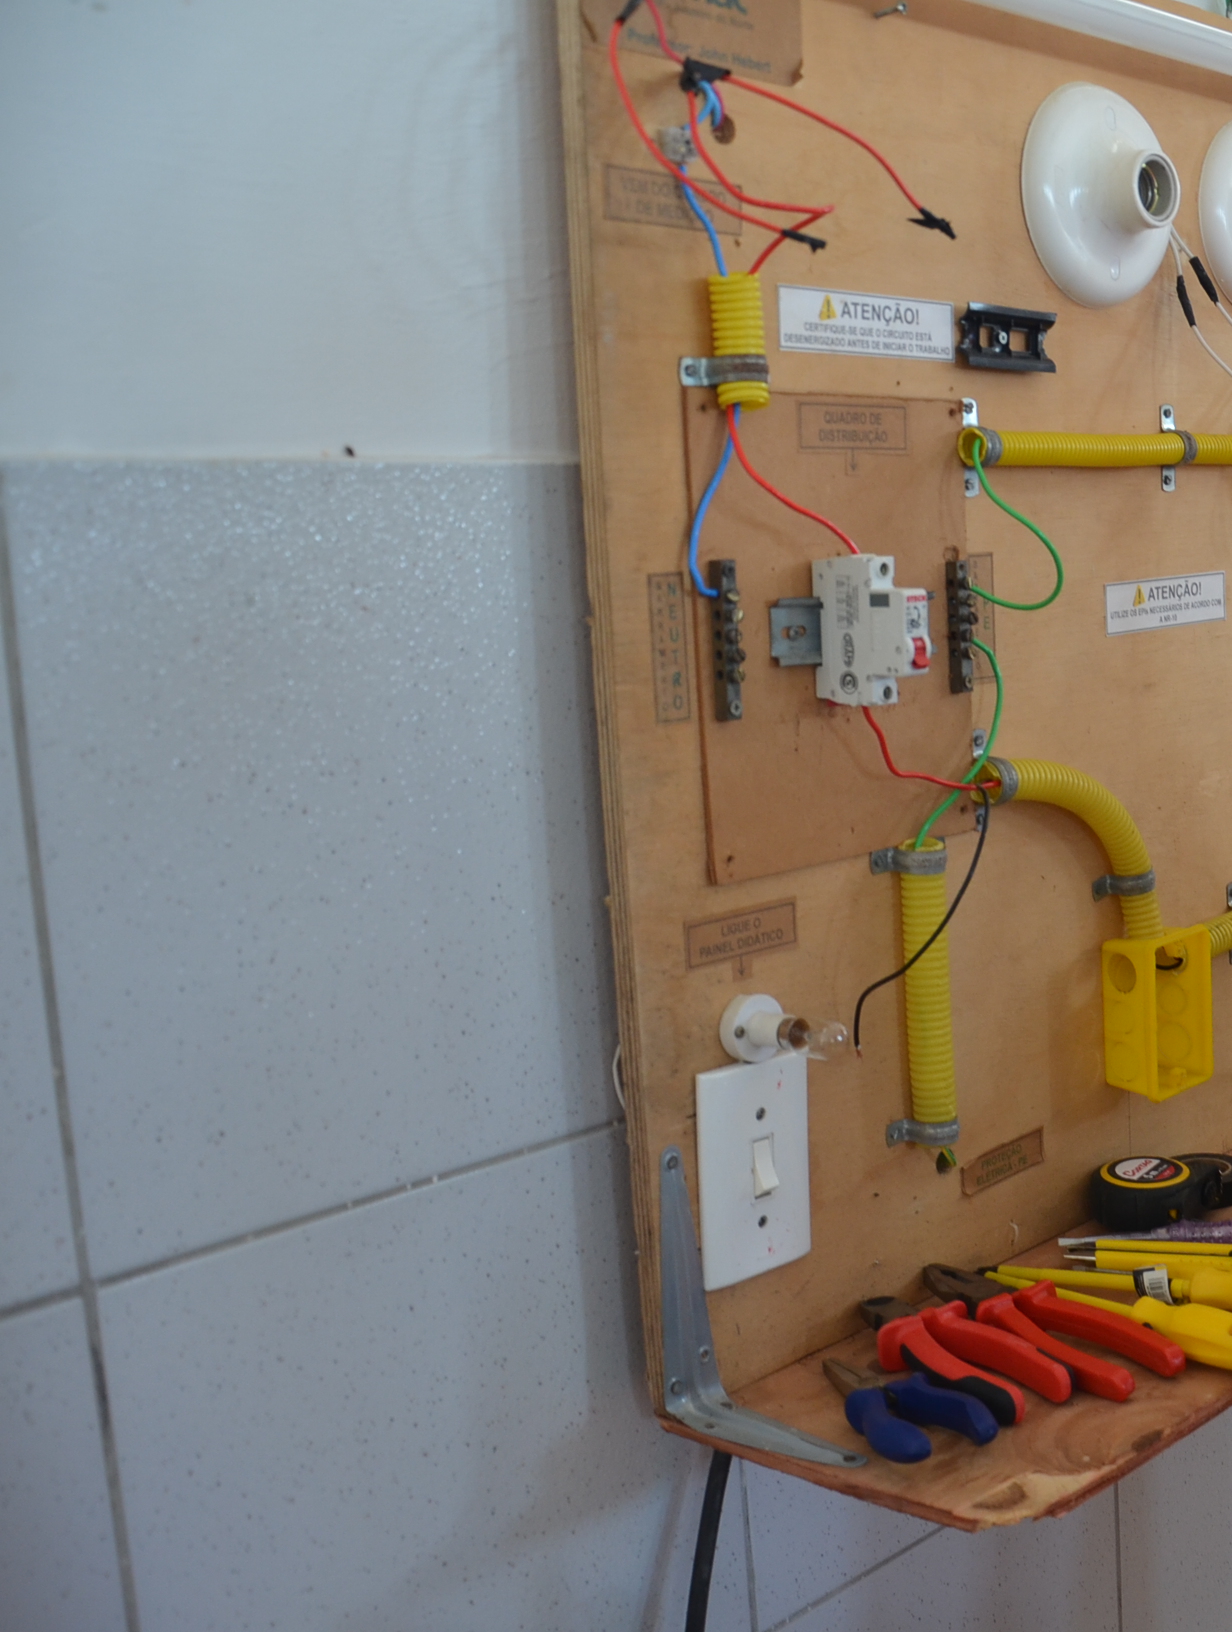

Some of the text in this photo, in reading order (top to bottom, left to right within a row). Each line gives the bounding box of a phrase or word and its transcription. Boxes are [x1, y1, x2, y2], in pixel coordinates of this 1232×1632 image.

[841, 302, 920, 326] ATENÇÃO!
[803, 322, 932, 342] CERTIFIQUE-SE QUE O CIRCUITO ESTÁ
[783, 333, 950, 356] DESENERGIZADO ANTES DE INICIAR O TRABALHO
[823, 410, 882, 426] QUADRO DE
[818, 427, 888, 446] DISTRIBUIÇÃO
[1148, 580, 1202, 602] ATENÇÃO!
[1110, 609, 1129, 620] UTILIZE
[1129, 608, 1138, 617] OS
[1149, 603, 1183, 615] NECESSÁRIOS
[1183, 602, 1190, 610] DE
[1191, 599, 1210, 609] ACORDO
[1210, 598, 1222, 607] COM
[666, 581, 684, 711] NEUTRO
[721, 918, 761, 937] LIGUE O
[699, 928, 784, 959] PAINEL DIDÁTICO
[981, 1144, 1022, 1169] PROTEÇÃO
